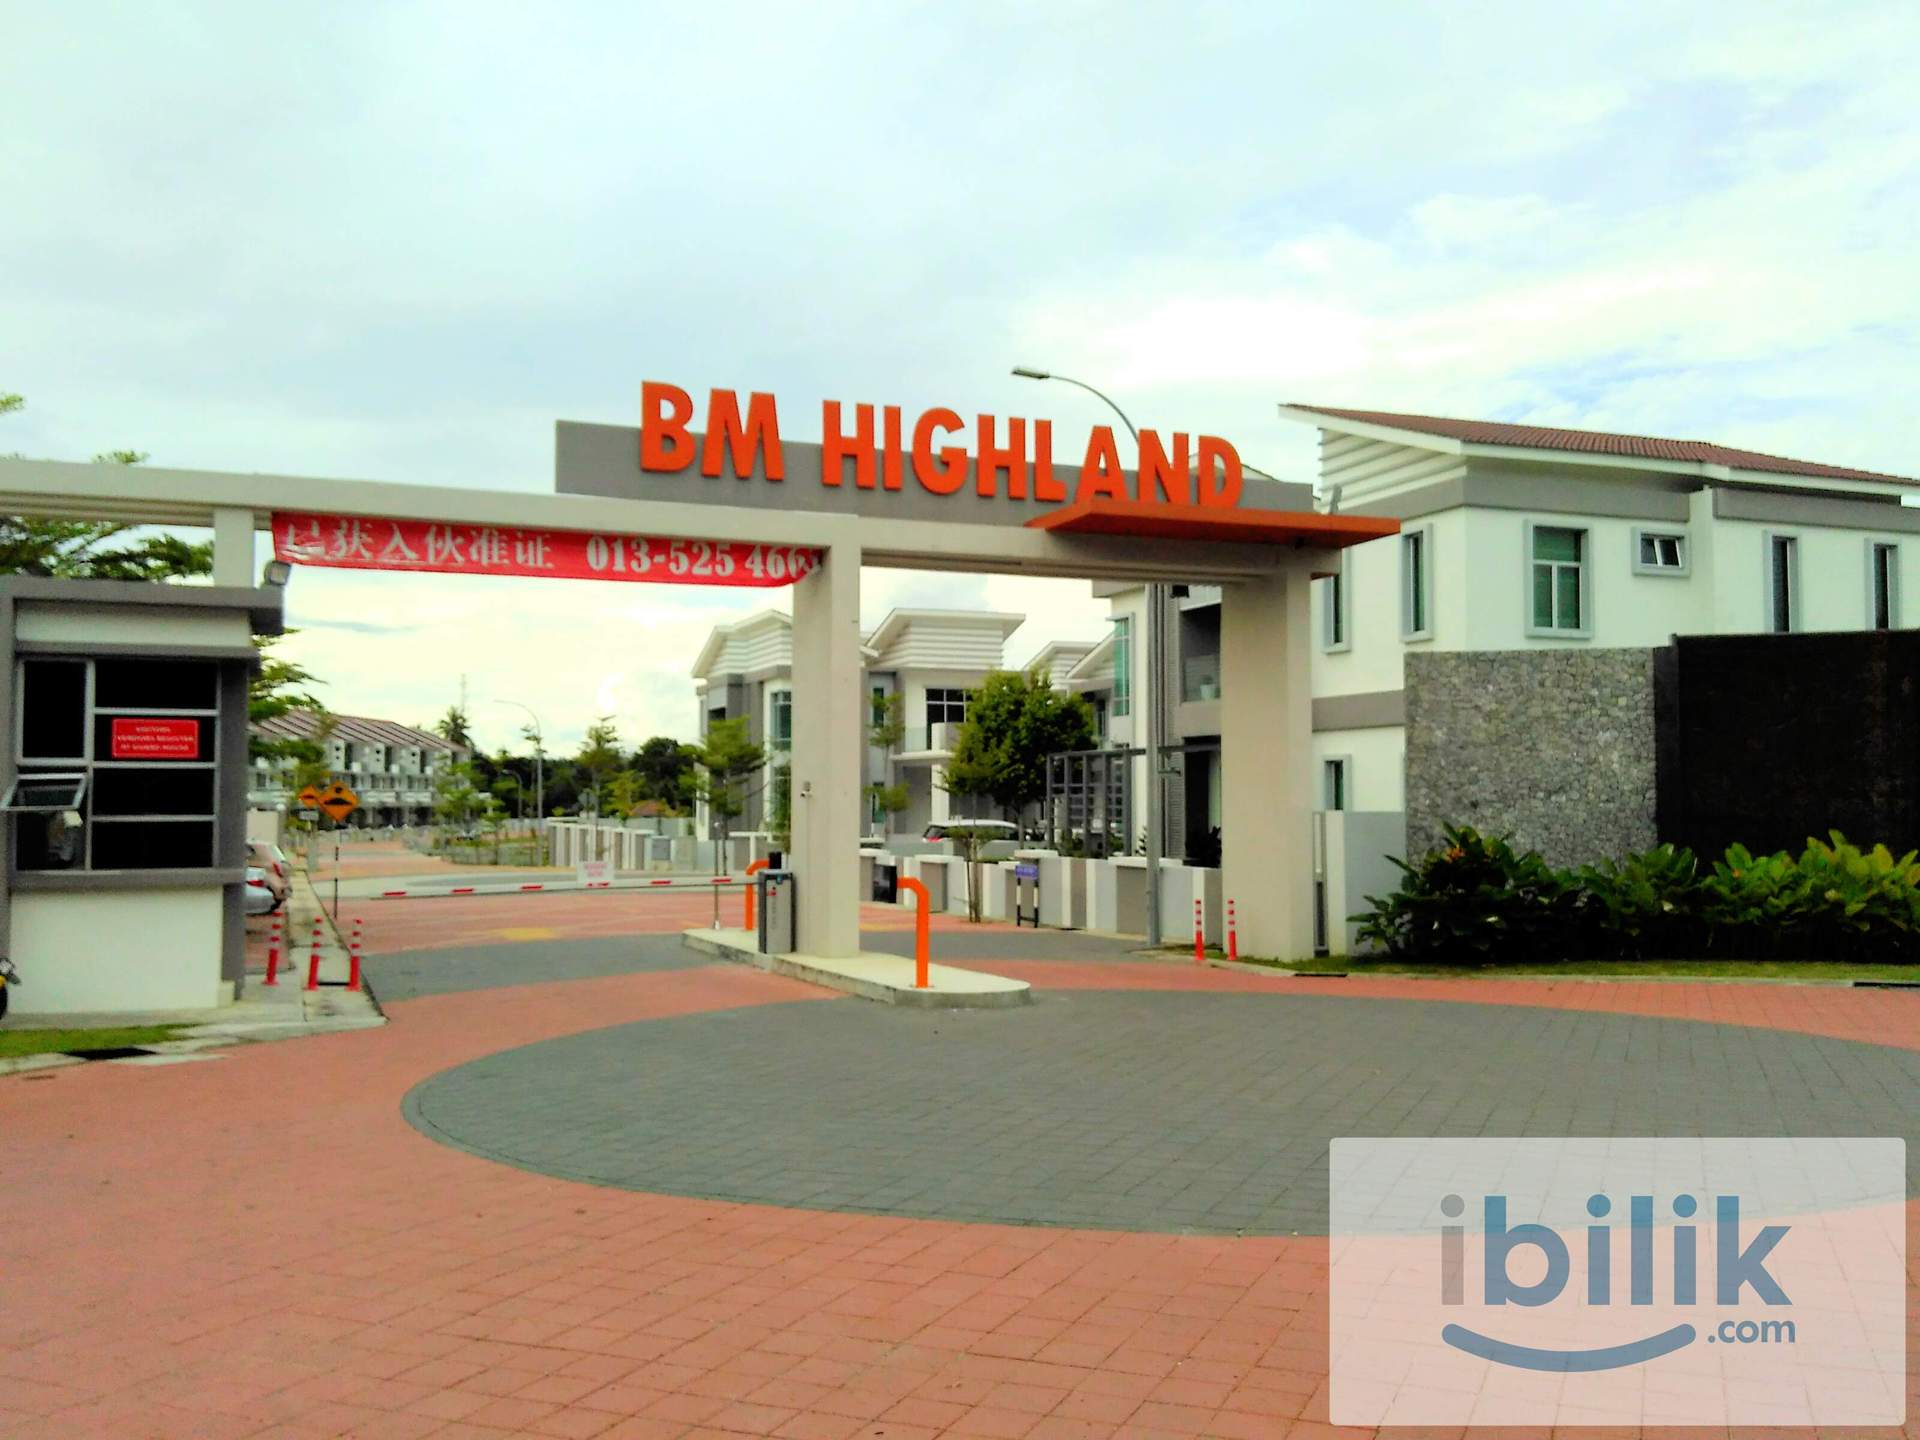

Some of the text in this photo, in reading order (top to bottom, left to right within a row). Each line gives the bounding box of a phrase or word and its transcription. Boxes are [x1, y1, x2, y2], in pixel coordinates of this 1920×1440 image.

[641, 380, 1243, 507] BM HIGHLAND
[586, 535, 734, 577] 013-525
